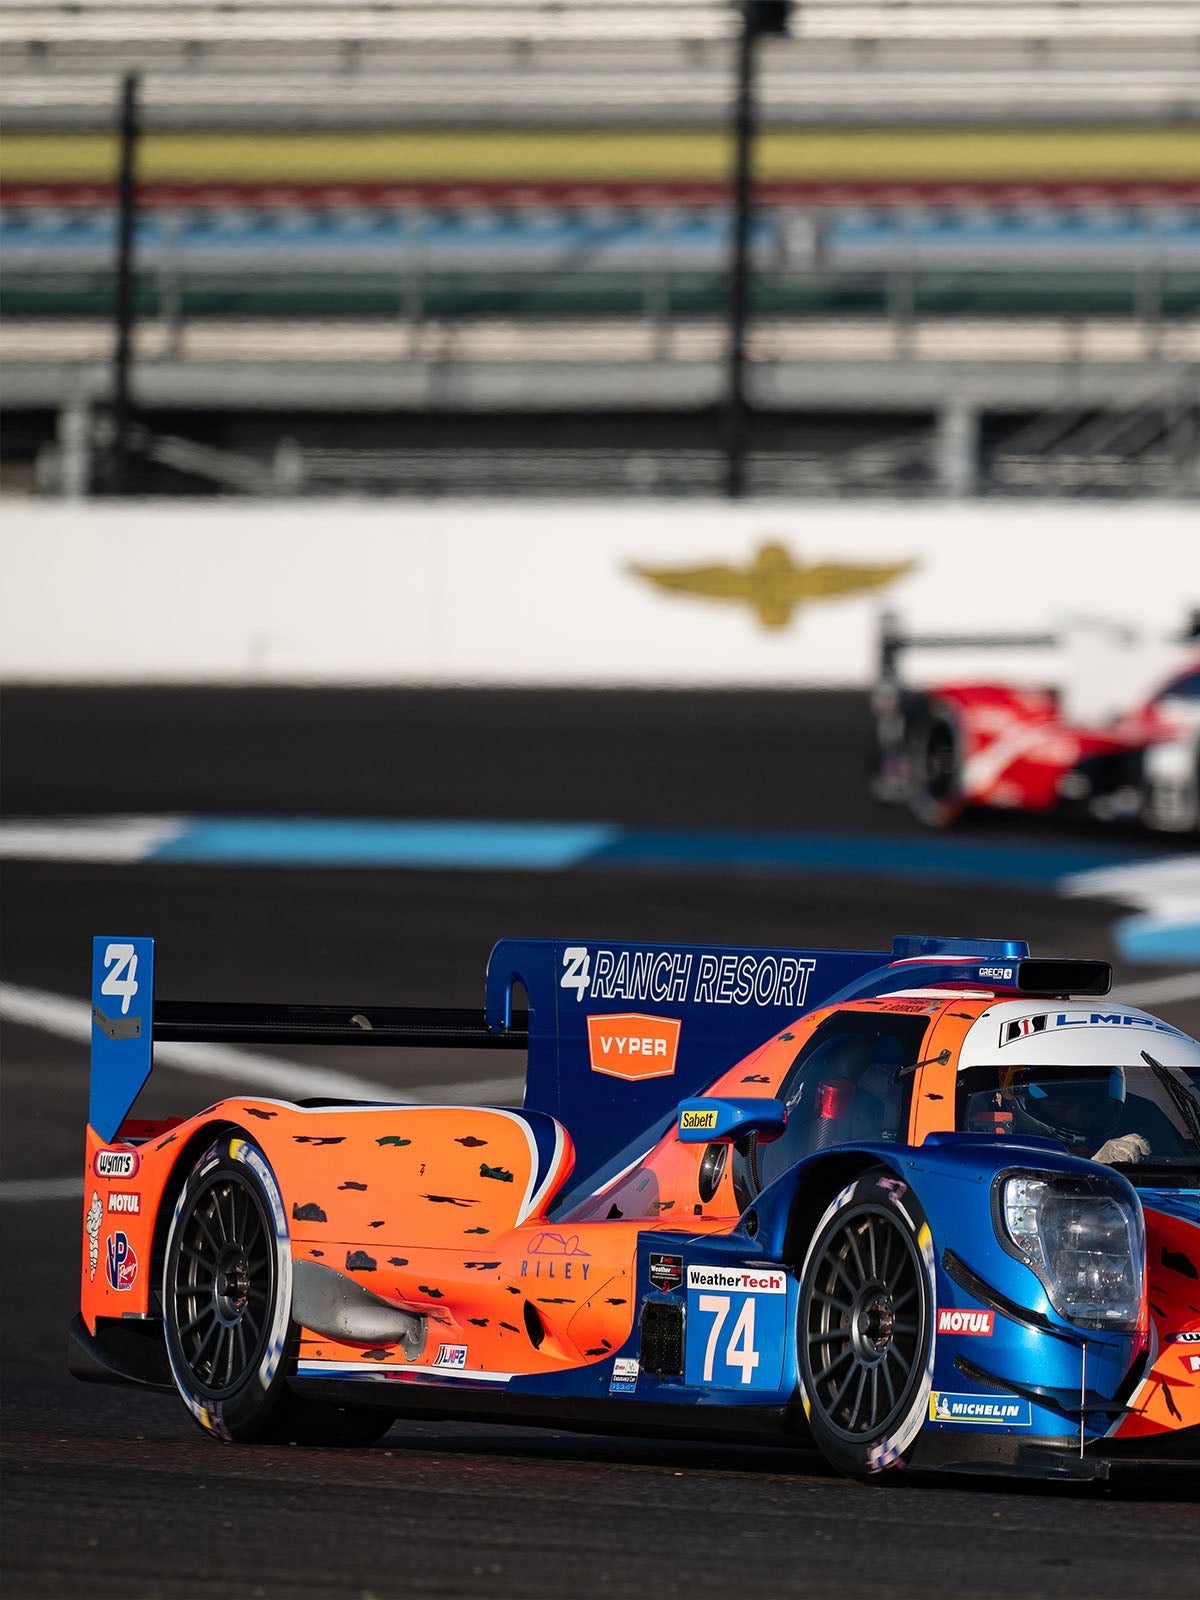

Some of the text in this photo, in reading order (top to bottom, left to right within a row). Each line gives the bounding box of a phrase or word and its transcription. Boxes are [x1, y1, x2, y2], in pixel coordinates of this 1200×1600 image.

[590, 950, 693, 1002] RANCH
[694, 955, 817, 1006] RESORT
[600, 1036, 667, 1056] VYPER
[683, 1112, 714, 1128] Sabelt
[108, 1193, 139, 1213] MOTUL
[107, 1230, 128, 1290] VP
[520, 1260, 590, 1281] RILEY
[690, 1271, 780, 1289] WeatherTech
[939, 1312, 991, 1333] MOTUL
[699, 1294, 760, 1384] 74
[442, 1349, 466, 1365] LMP2
[951, 1403, 1019, 1416] MICHELIN
